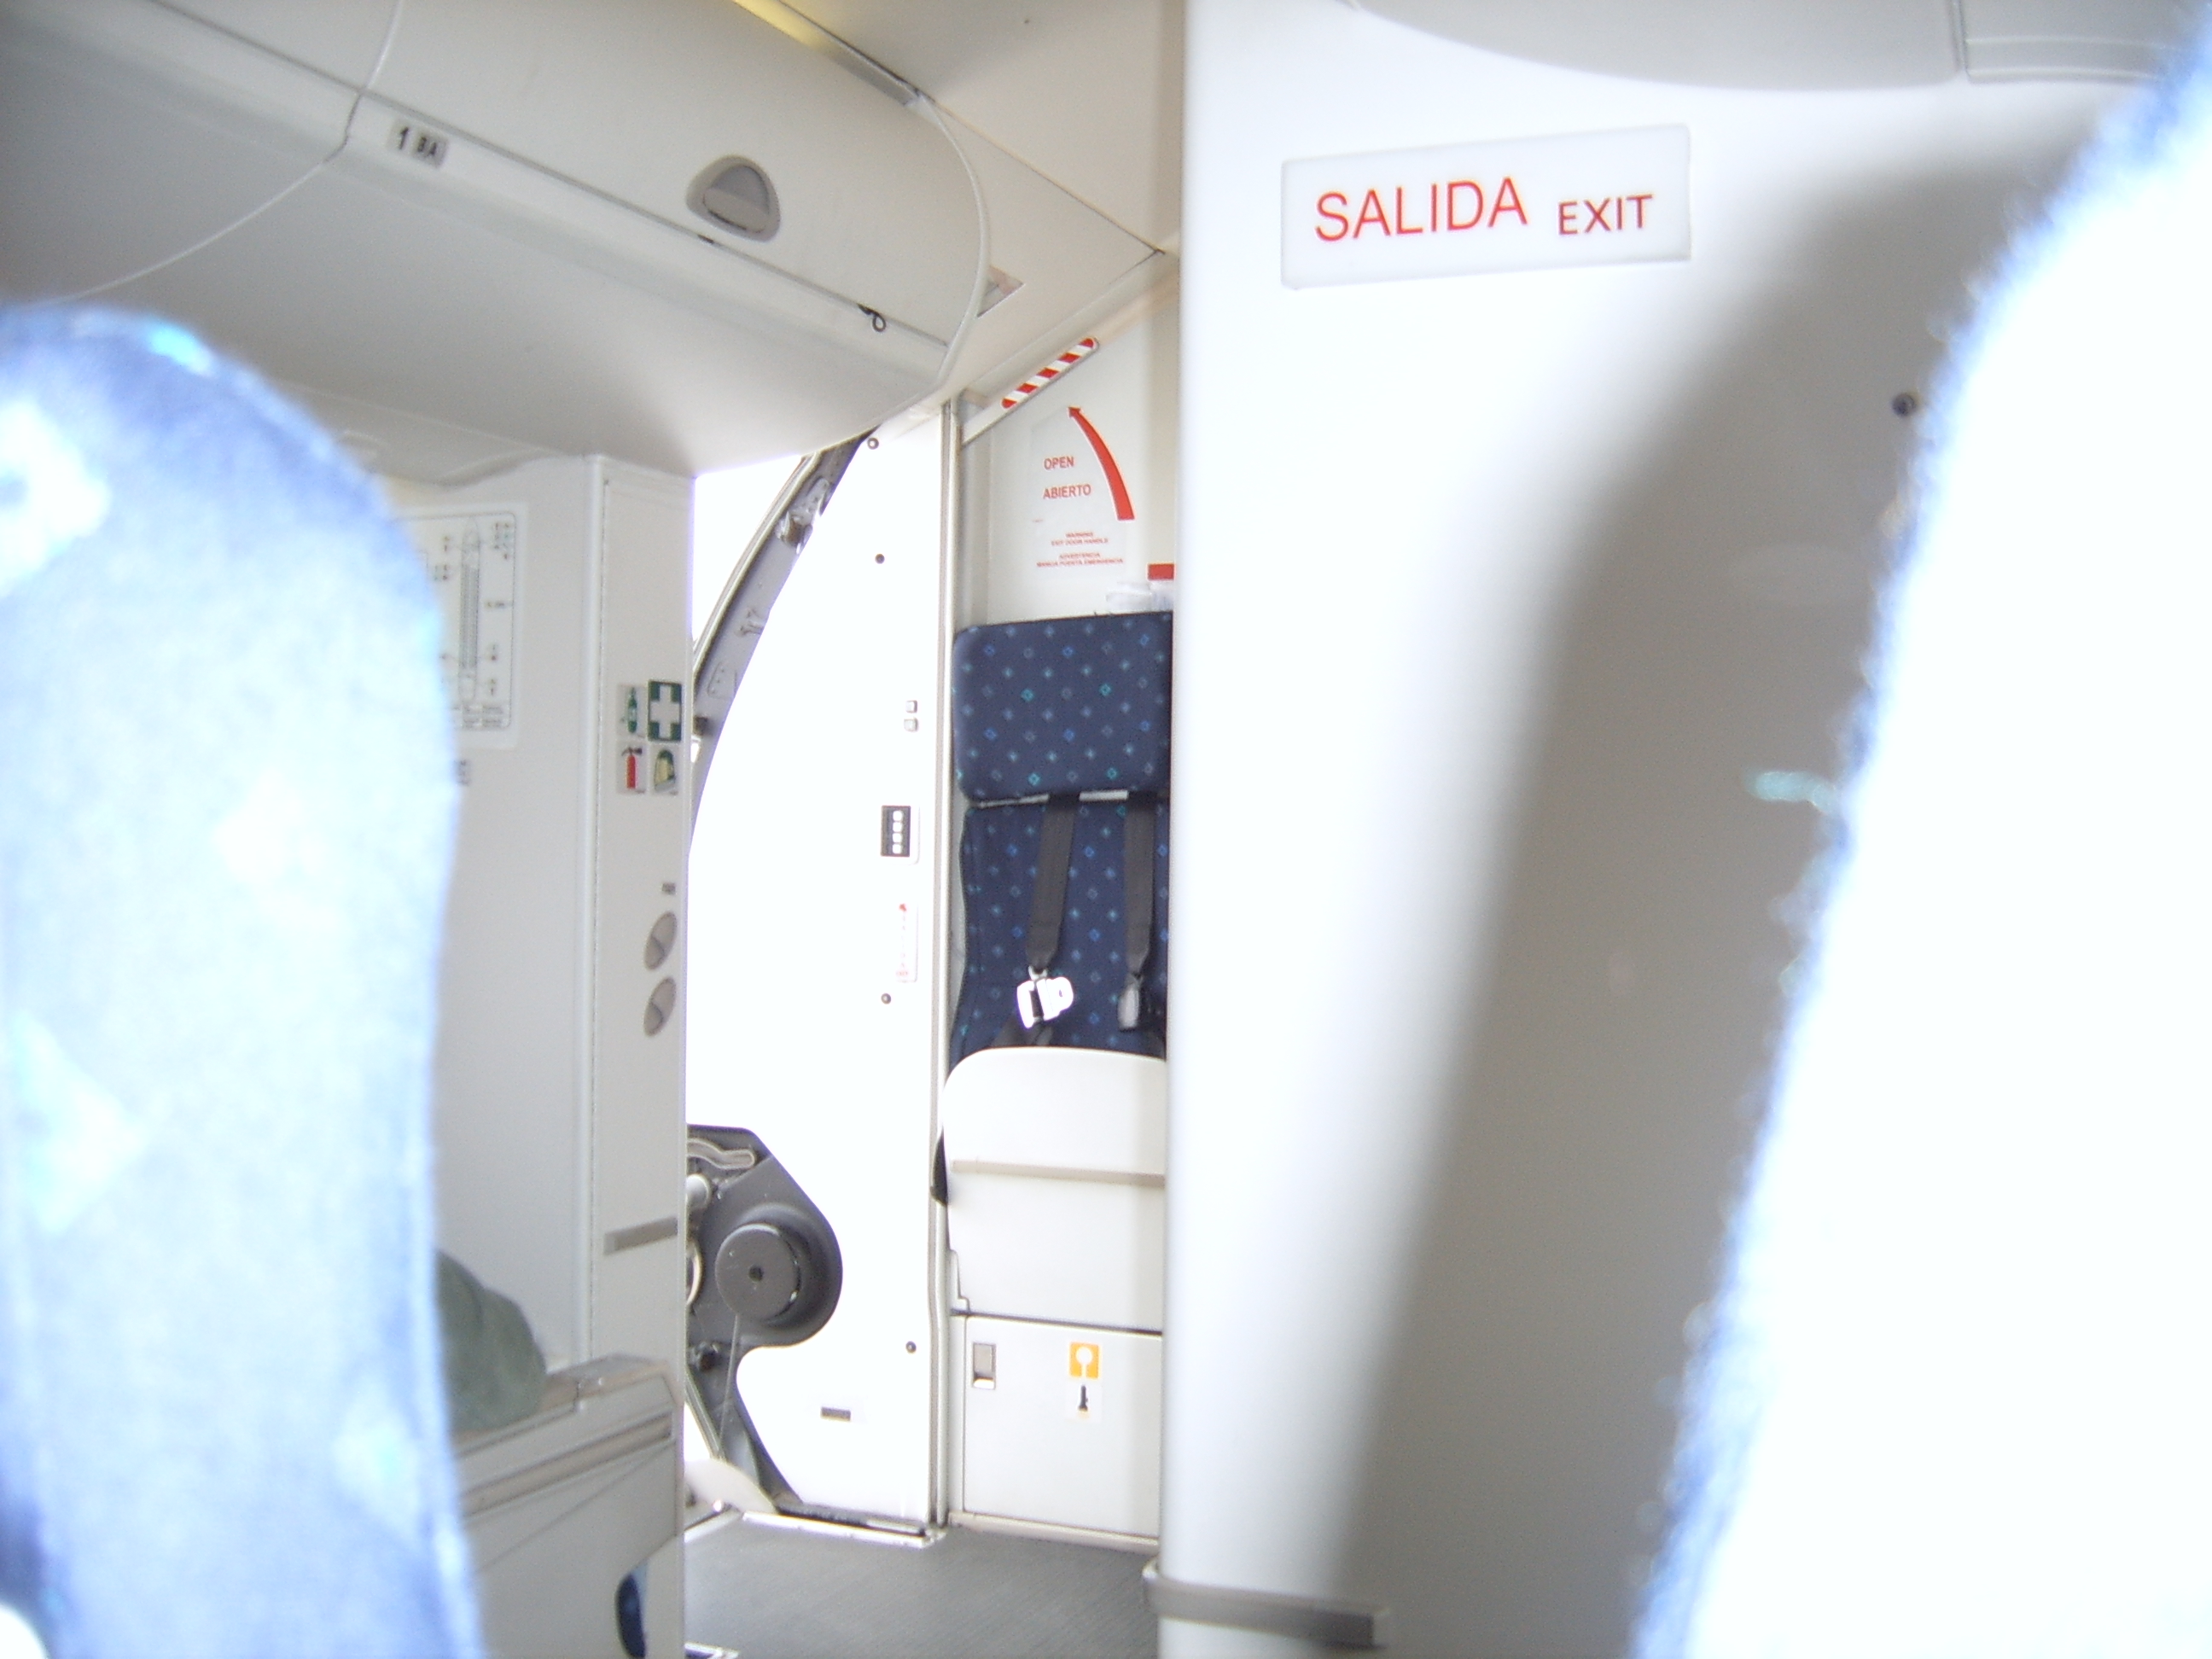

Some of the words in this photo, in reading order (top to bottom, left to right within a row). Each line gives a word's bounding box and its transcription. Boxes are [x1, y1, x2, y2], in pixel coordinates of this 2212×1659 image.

[398, 127, 409, 150] 1
[1314, 176, 1528, 242] SALIDA
[1557, 193, 1654, 236] EXIT
[1044, 456, 1074, 470] OPEN
[1043, 484, 1091, 499] ABIERTO
